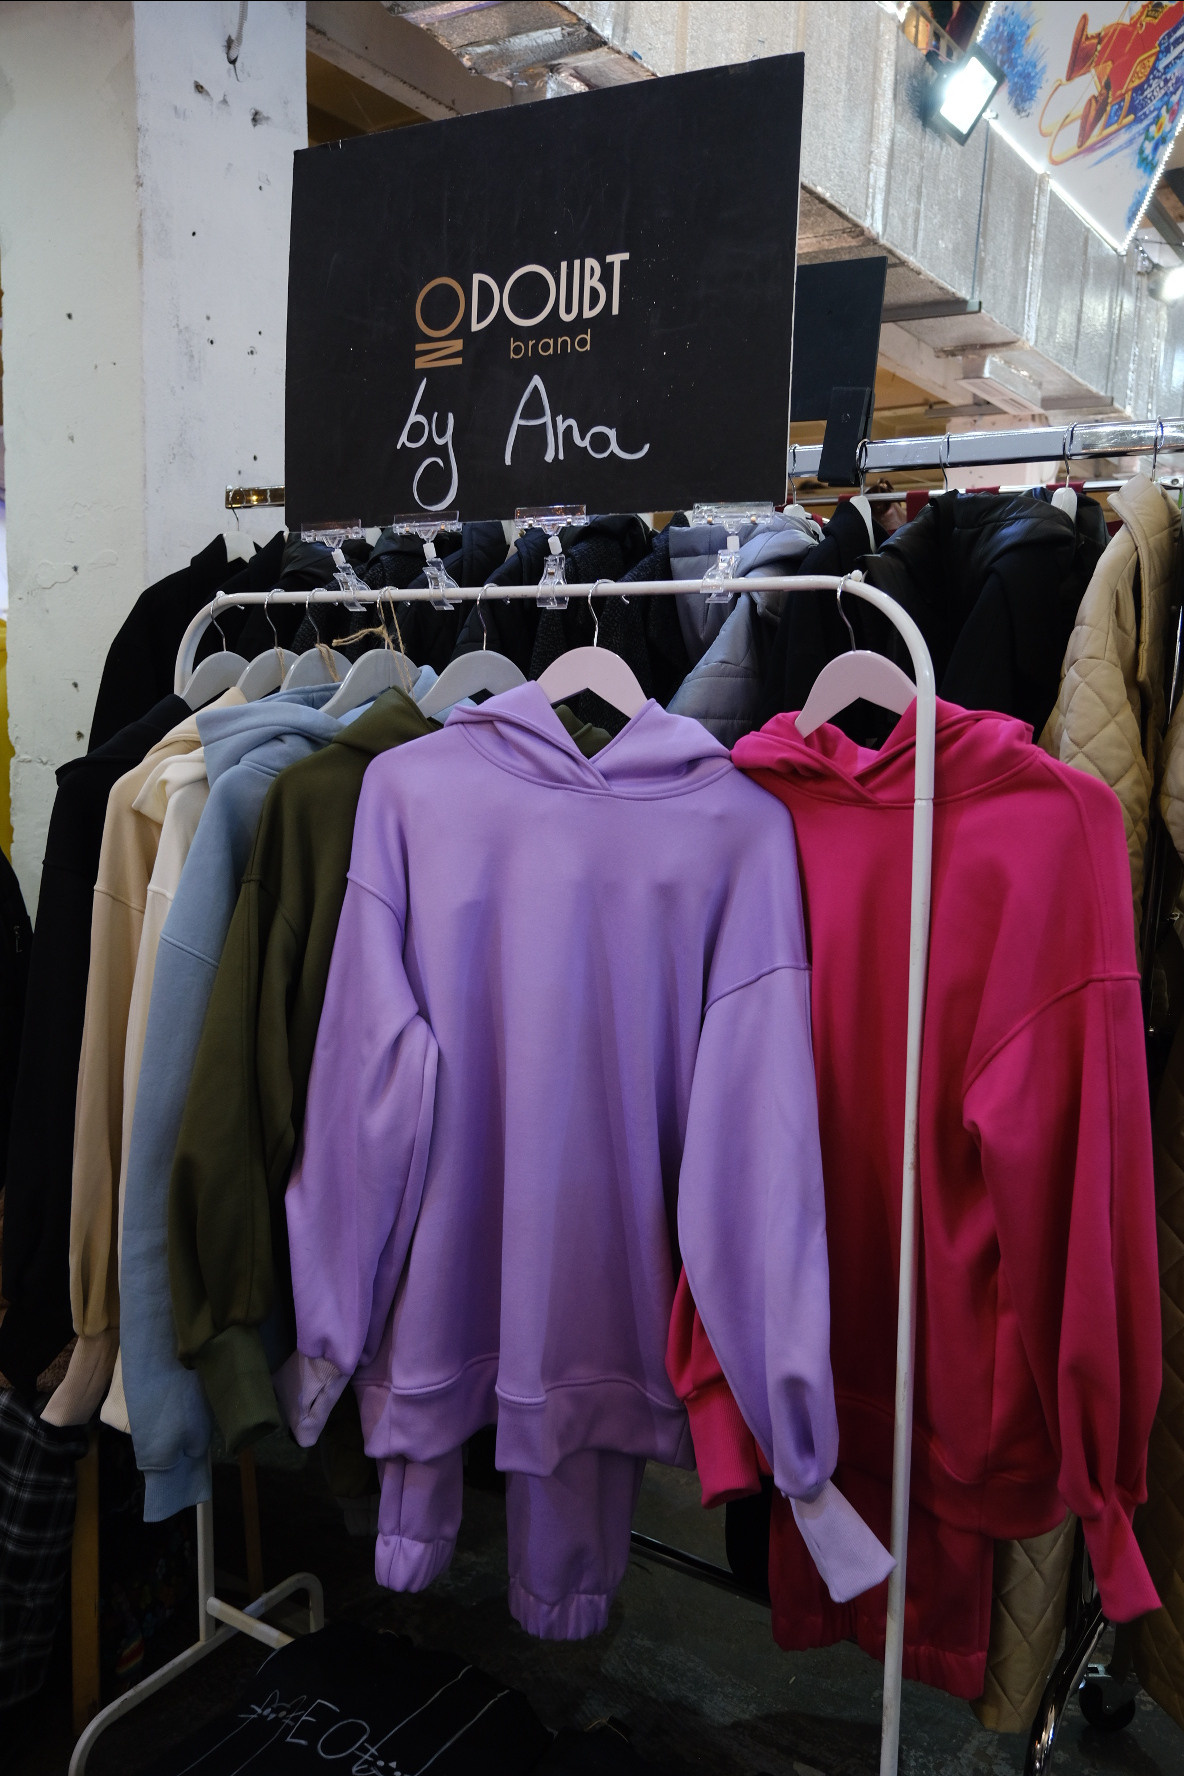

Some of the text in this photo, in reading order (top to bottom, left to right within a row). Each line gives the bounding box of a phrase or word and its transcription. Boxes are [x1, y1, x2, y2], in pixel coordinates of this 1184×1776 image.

[414, 252, 630, 370] NO DOUBT
[509, 328, 592, 360] brand
[396, 374, 651, 512] by Ana
